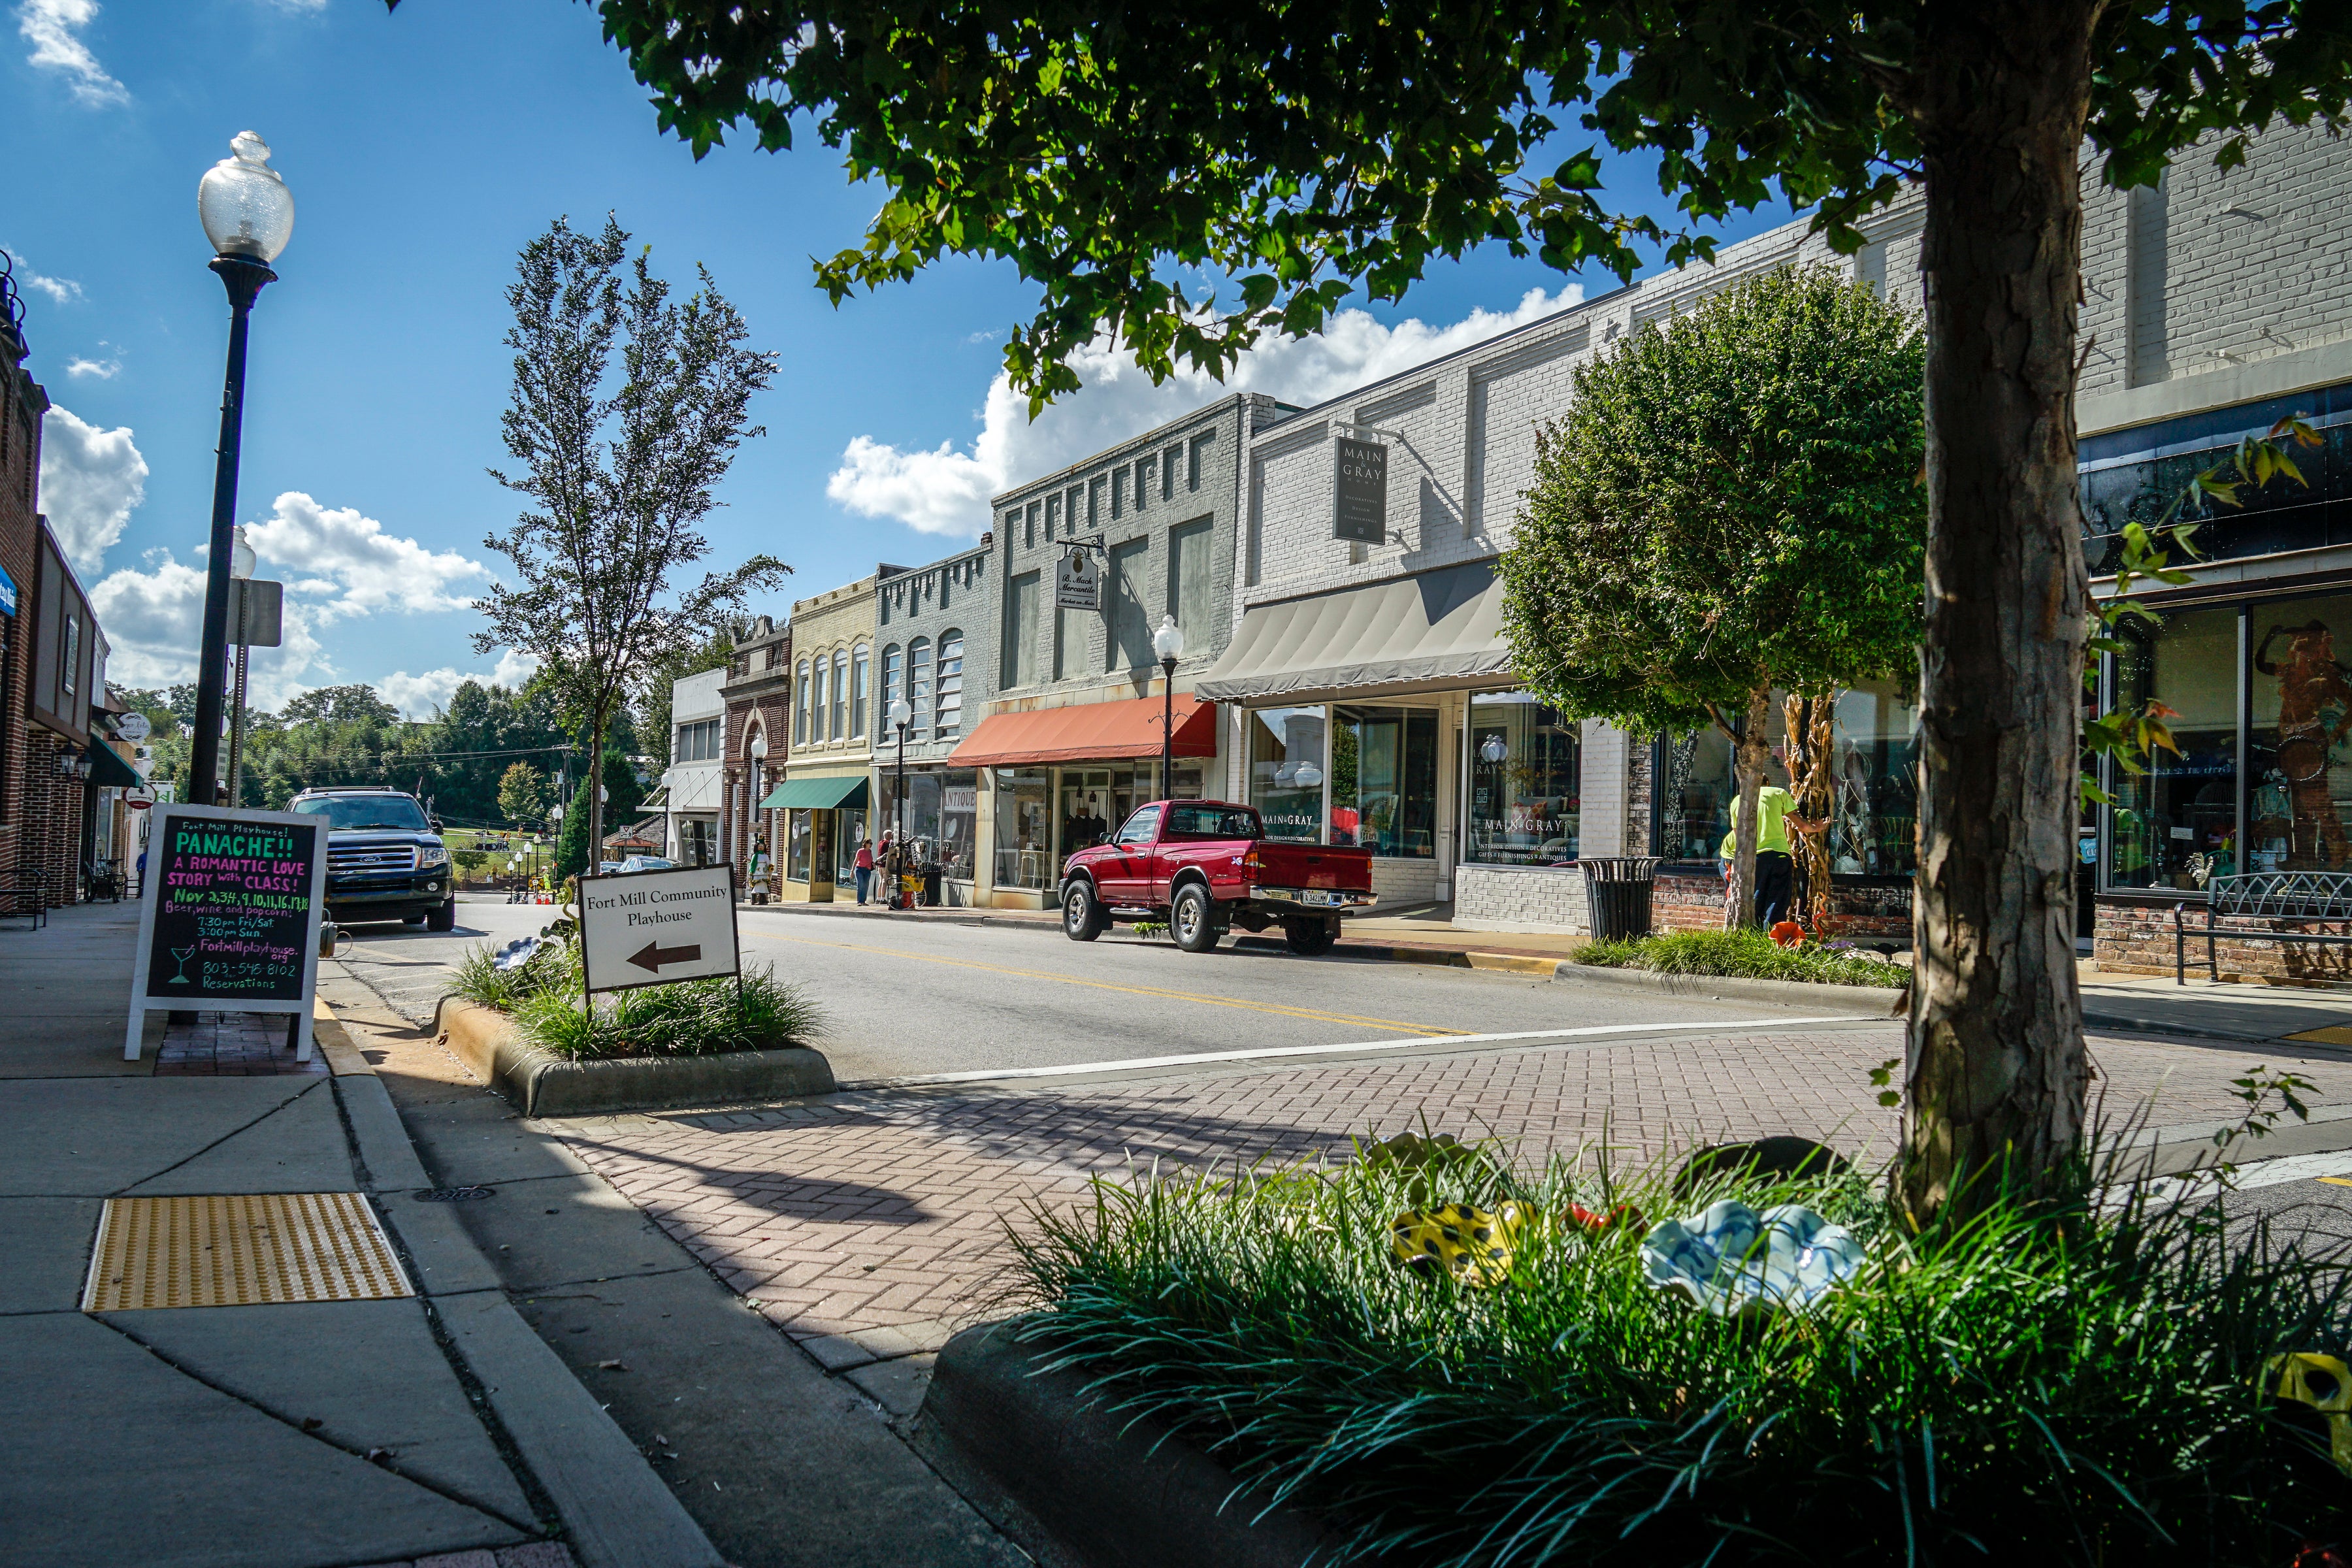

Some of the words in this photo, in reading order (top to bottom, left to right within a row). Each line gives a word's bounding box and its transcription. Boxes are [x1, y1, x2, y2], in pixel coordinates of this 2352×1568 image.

[1345, 448, 1381, 463] MAIN
[1343, 465, 1382, 480] GRAY
[1062, 574, 1071, 583] B.
[1073, 576, 1093, 585] Mack
[1059, 583, 1096, 594] Mercantile
[1261, 815, 1283, 825] MAIN
[1288, 815, 1313, 825] GRAY
[1484, 819, 1518, 830] MAIN
[1526, 819, 1562, 832] GRAY
[208, 823, 226, 831] Mill
[233, 824, 288, 838] Playhouse!
[176, 832, 293, 858] PANACHE!!
[174, 857, 183, 869] A
[190, 857, 267, 873] ROMANTIC
[273, 861, 306, 876] LOVE
[167, 872, 213, 886] STORY
[245, 875, 298, 892] CLASS!
[174, 889, 204, 903] Nov
[587, 896, 615, 910] Fort
[619, 891, 647, 907] Mill
[650, 885, 727, 904] Community
[225, 904, 244, 913] and
[246, 907, 292, 919] popcorn!
[627, 911, 693, 926] Playhouse
[238, 917, 274, 929] Fri/Sat.
[238, 928, 263, 938] Sun.
[271, 954, 288, 964] org
[203, 975, 276, 988] Reservations
